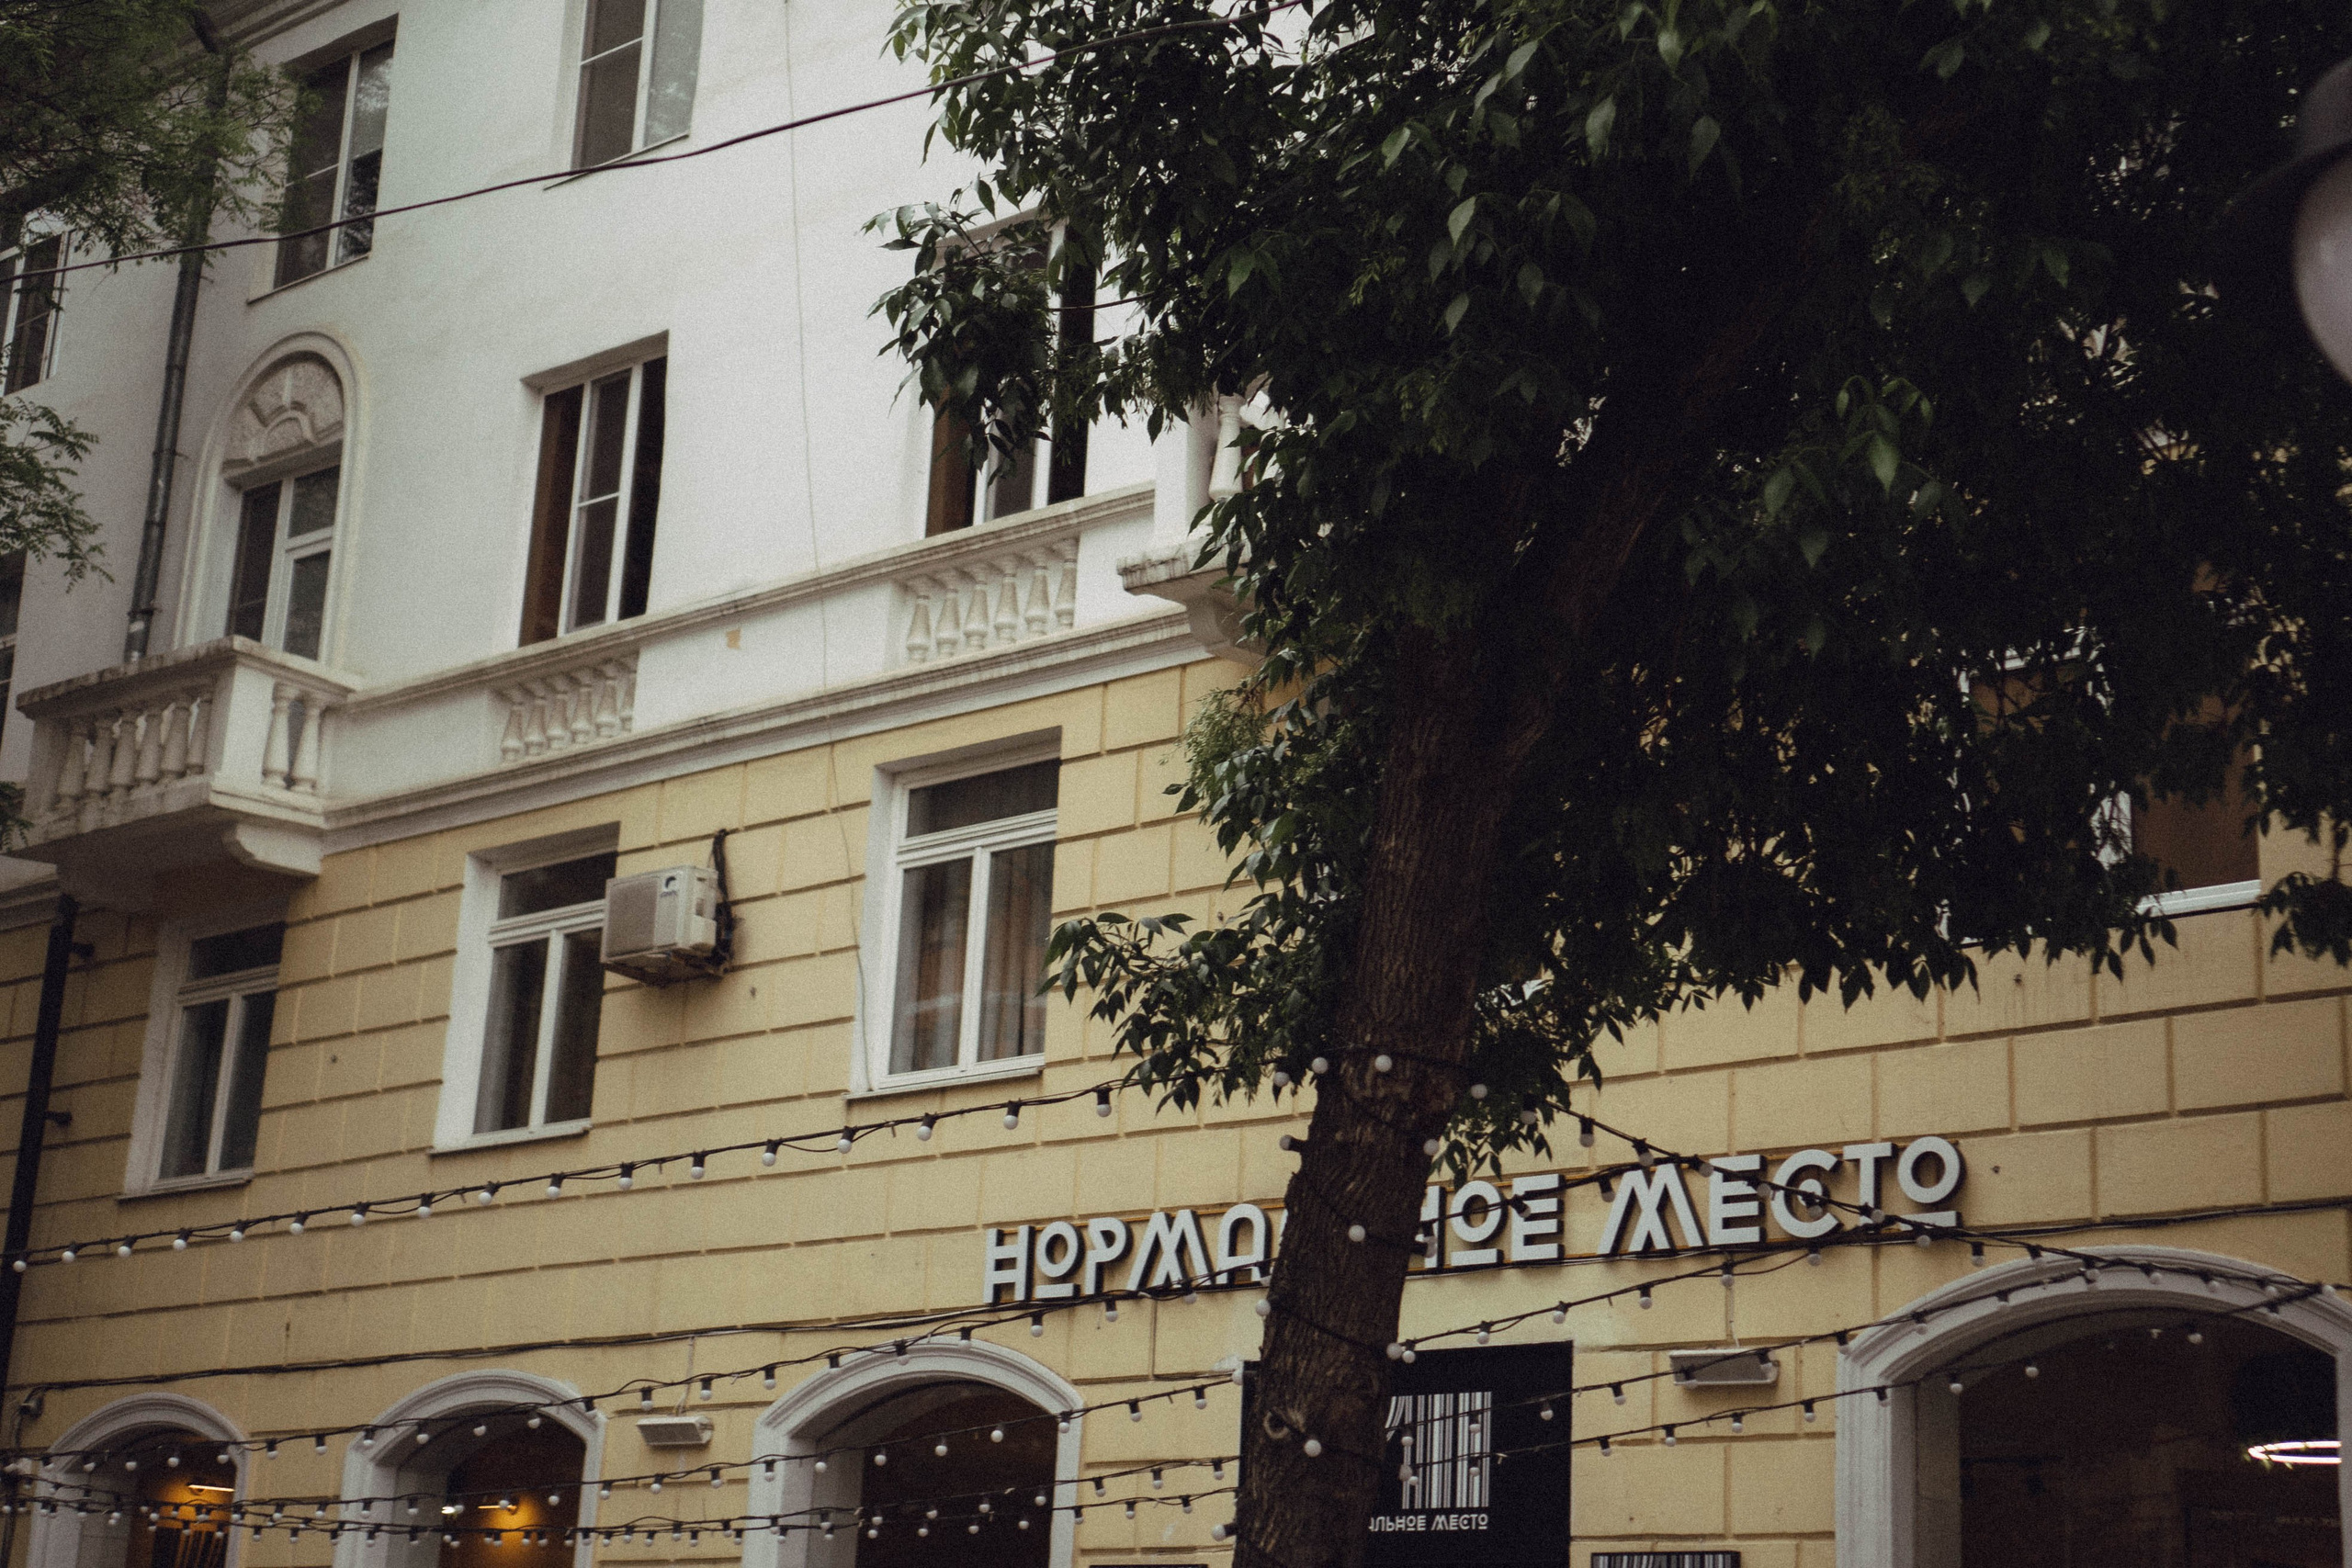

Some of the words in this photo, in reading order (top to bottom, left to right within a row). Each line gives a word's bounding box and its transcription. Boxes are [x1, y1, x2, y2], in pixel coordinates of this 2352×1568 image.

[983, 1173, 1561, 1303] НОРМАОЕ
[1597, 1135, 1962, 1255] МЕСТО
[1430, 1513, 1488, 1531] МЕСТО
